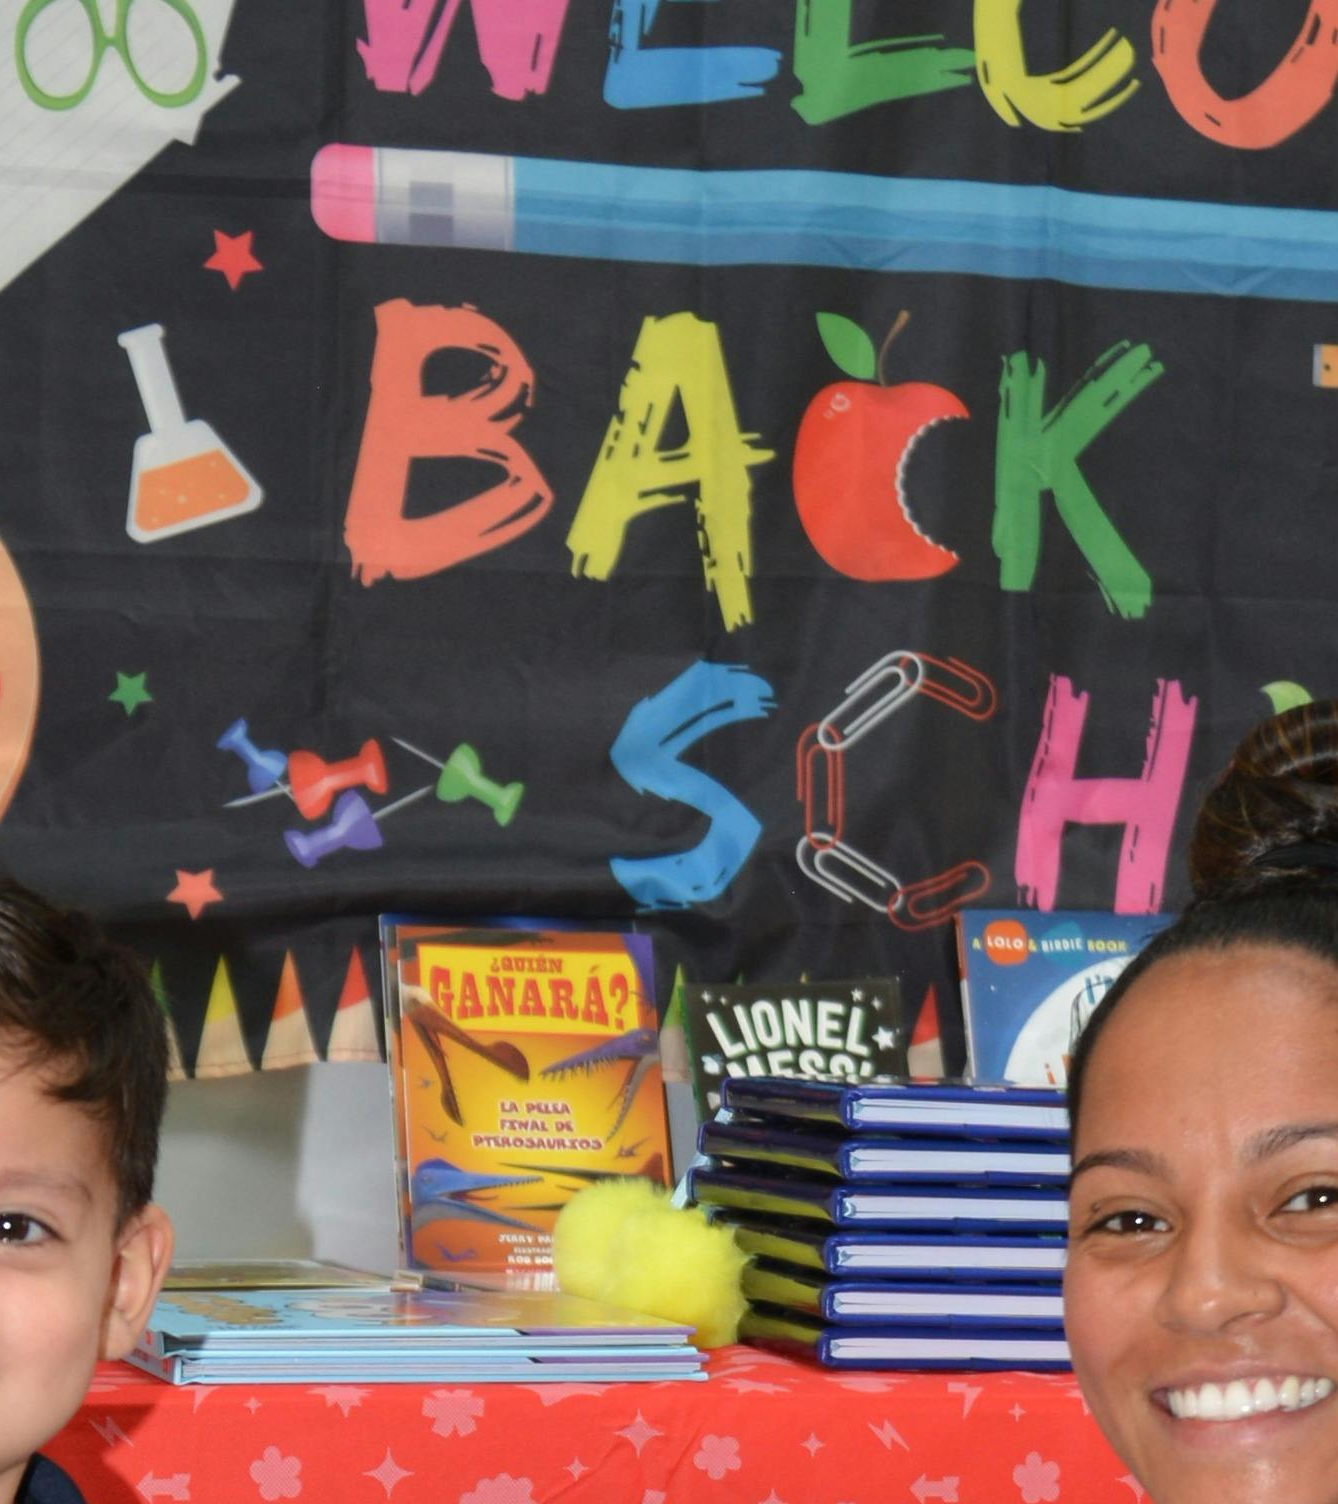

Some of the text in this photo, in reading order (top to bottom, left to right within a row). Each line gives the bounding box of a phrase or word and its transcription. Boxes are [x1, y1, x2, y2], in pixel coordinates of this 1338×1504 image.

[972, 935, 1127, 953] A LOLO & BIRDIE BOOK
[490, 954, 563, 974] ¿QUIÉN
[429, 964, 631, 1030] GANARÁ?
[706, 998, 870, 1059] LIONEL
[499, 1100, 571, 1115] LA PELEA
[499, 1118, 574, 1133] FINAL DE
[472, 1134, 603, 1151] PTEROSAURIOS
